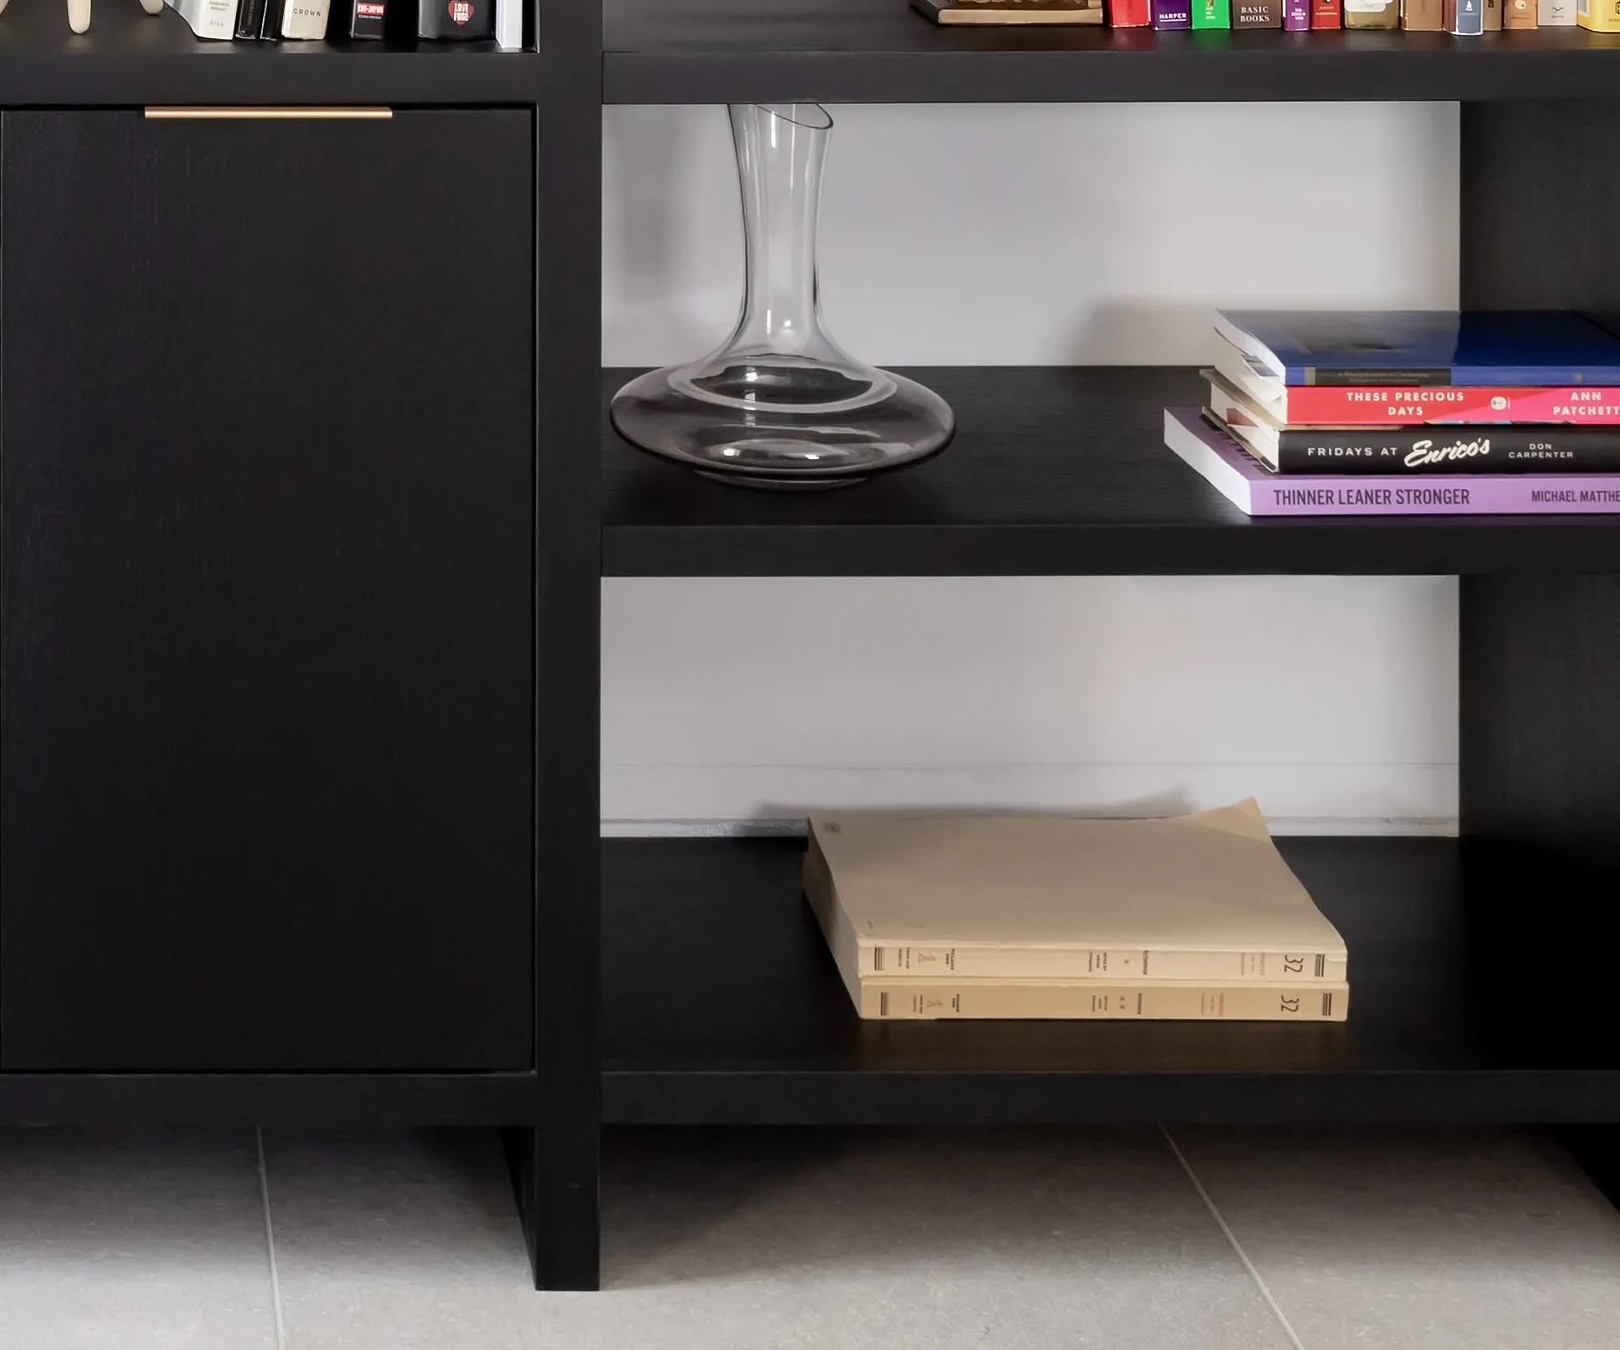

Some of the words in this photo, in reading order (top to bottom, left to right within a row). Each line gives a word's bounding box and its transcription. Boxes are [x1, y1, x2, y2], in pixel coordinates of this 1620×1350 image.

[1347, 392, 1390, 401] THESE
[1396, 392, 1464, 401] PRECIOUS
[1388, 406, 1423, 416] DAYS
[1308, 447, 1373, 456] FRIDAYS
[1380, 447, 1397, 455] AT
[1405, 438, 1490, 467] Enrico's
[1273, 490, 1334, 505] THINNER
[1338, 490, 1392, 504] LEANER
[1396, 489, 1470, 505] STRONGER
